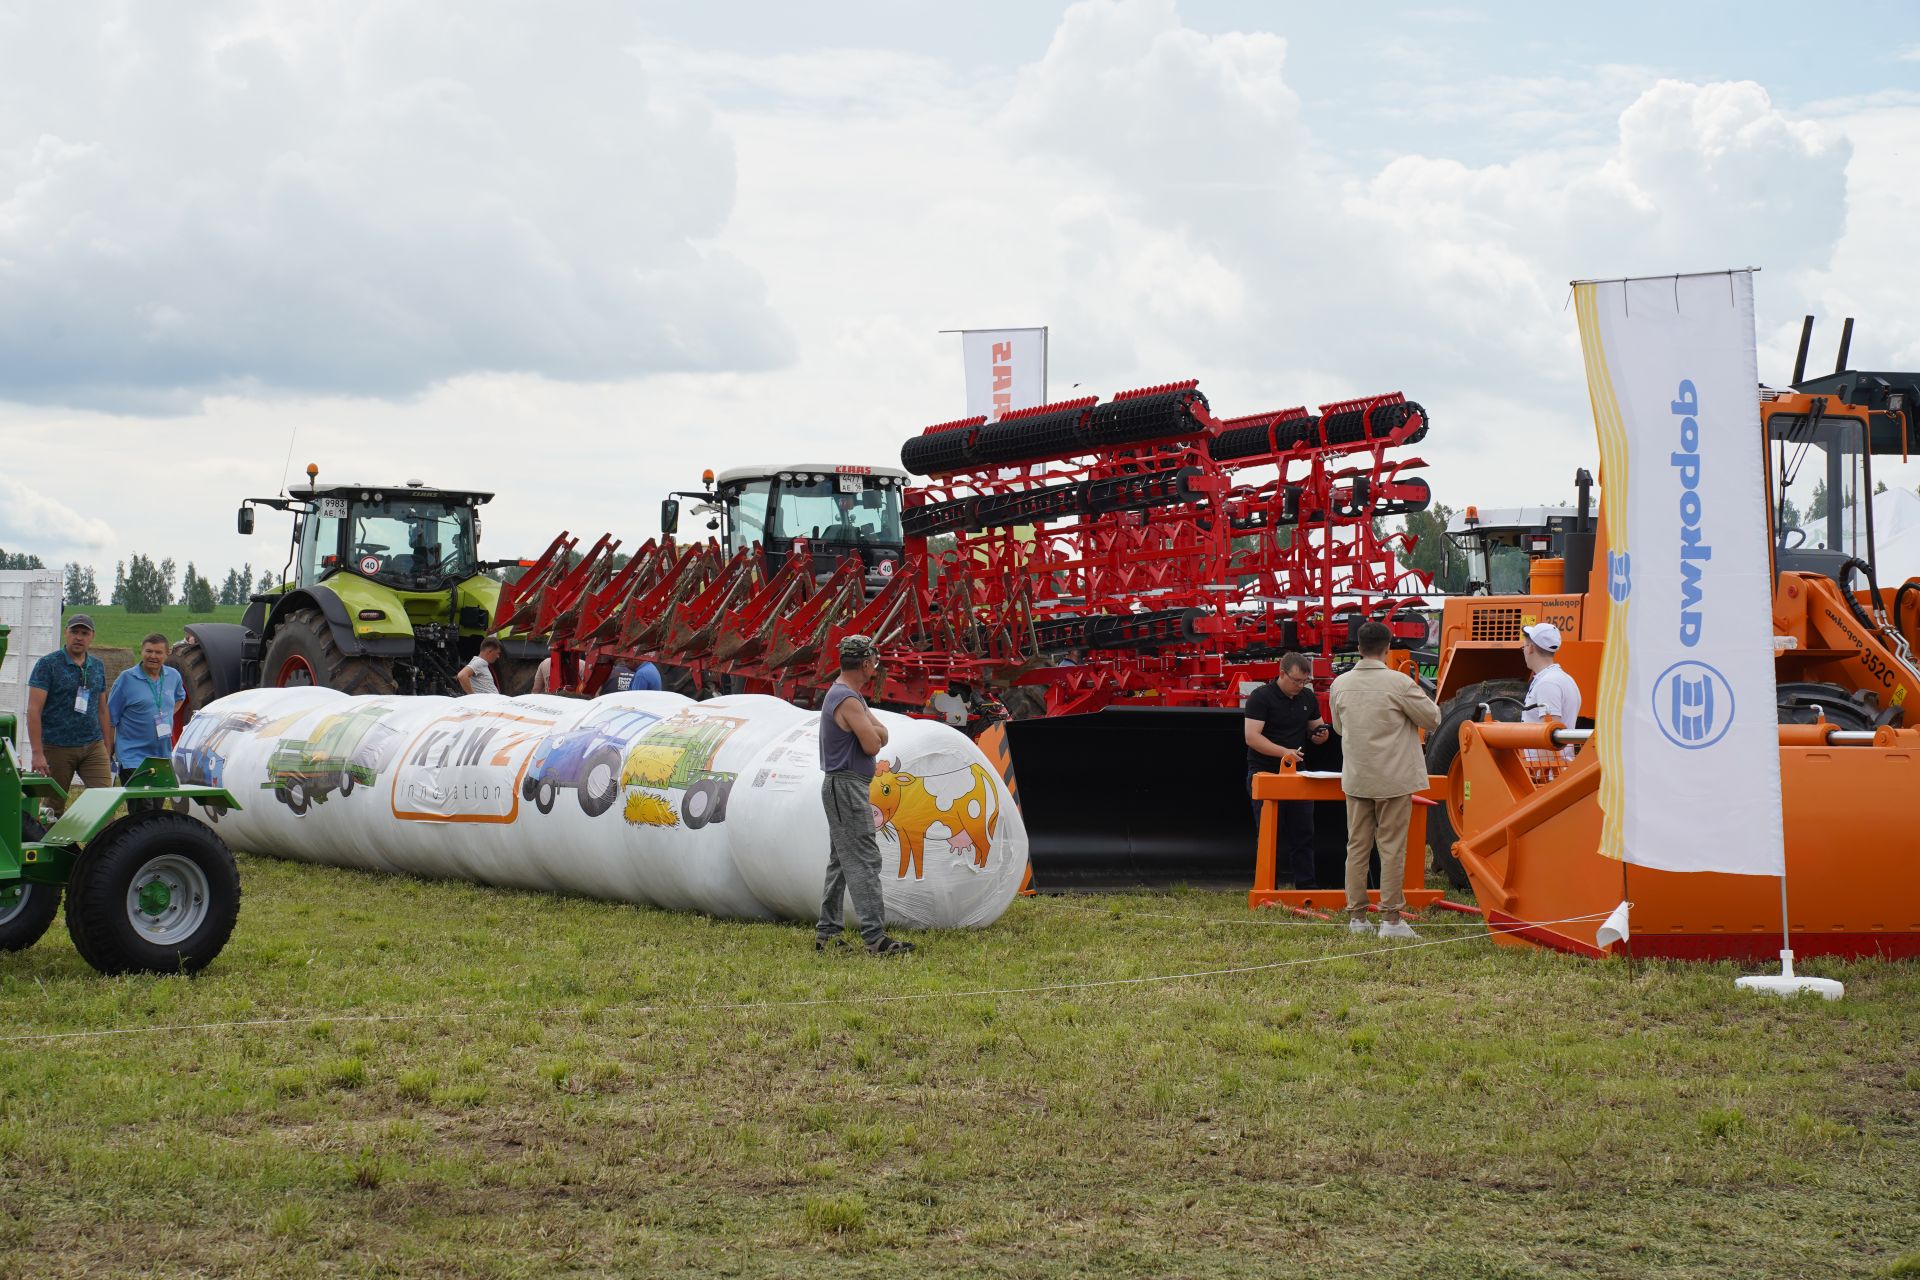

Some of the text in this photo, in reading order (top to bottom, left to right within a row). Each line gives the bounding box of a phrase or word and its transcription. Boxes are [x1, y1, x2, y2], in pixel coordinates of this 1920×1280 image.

[835, 465, 871, 475] CLAAS
[325, 499, 345, 508] 9983
[364, 561, 375, 569] 40
[1861, 648, 1895, 688] 352C
[400, 781, 501, 800] innovation
